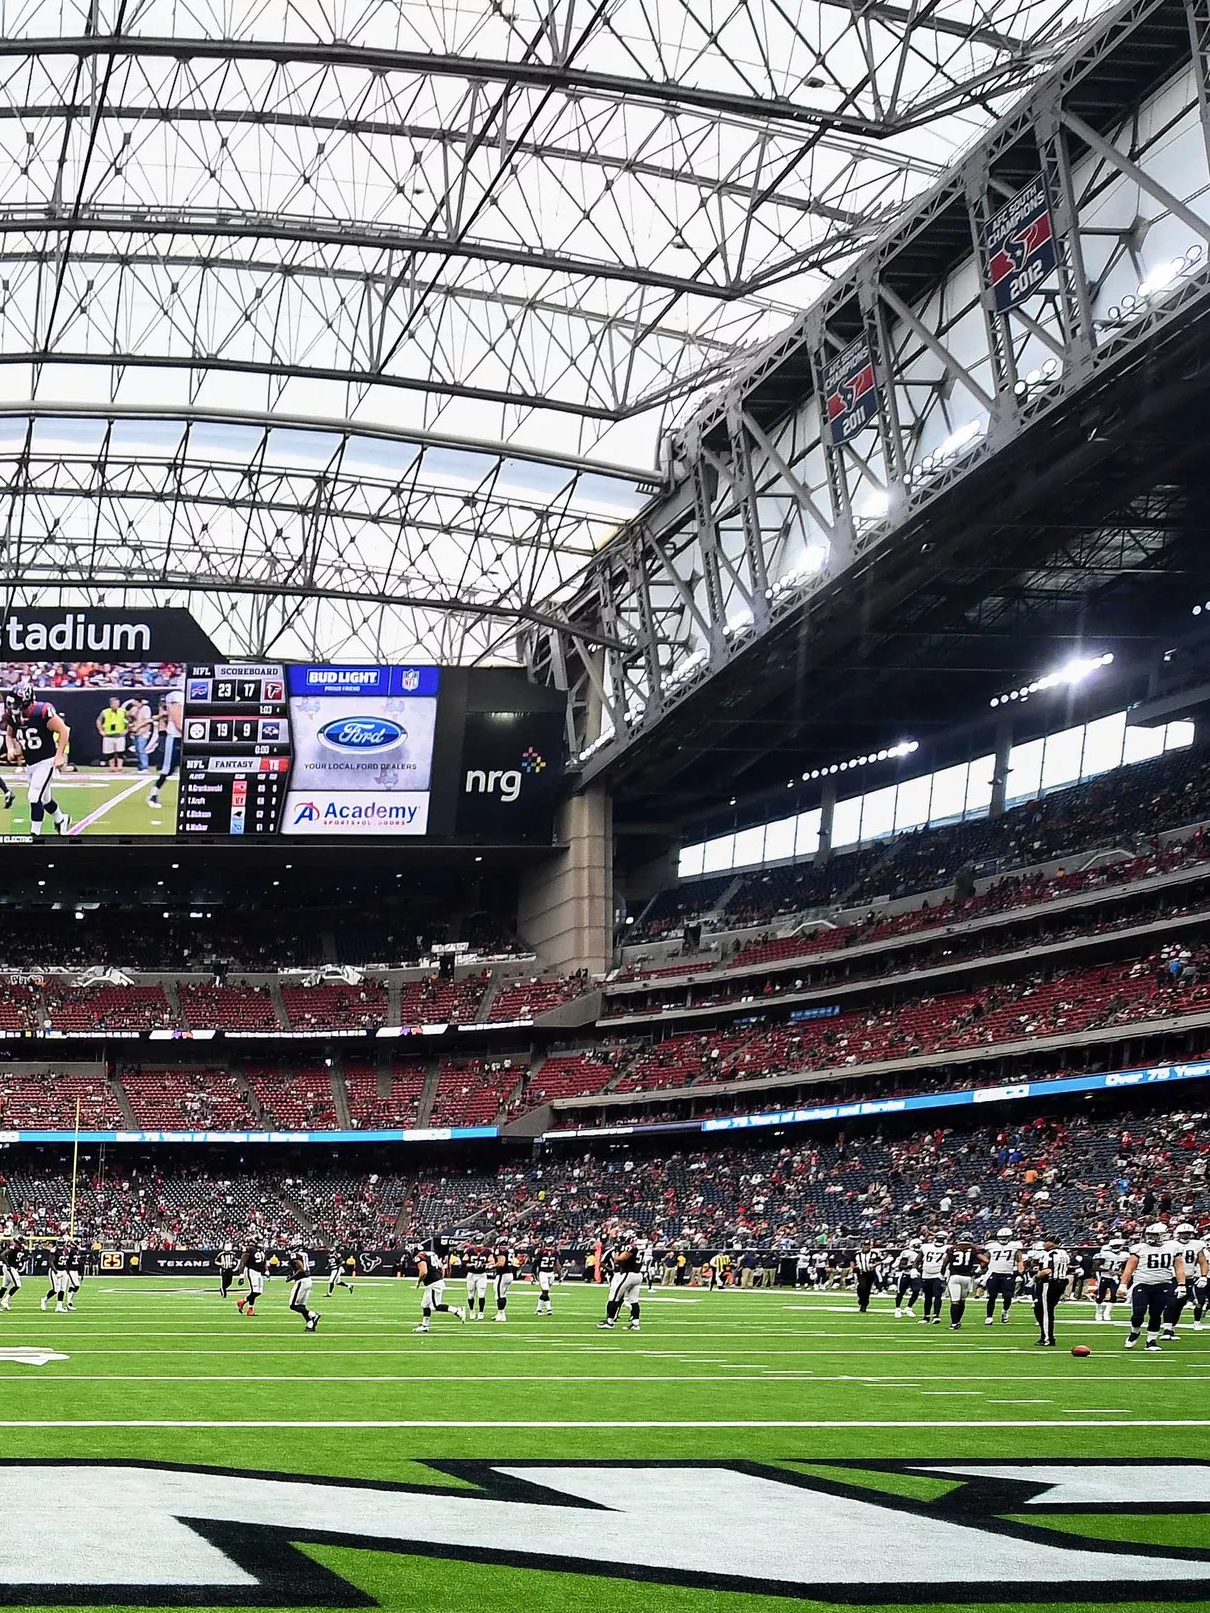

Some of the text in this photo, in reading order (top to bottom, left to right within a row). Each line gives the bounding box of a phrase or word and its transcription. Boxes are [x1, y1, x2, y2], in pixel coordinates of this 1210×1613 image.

[1009, 184, 1037, 214] SOUTH
[988, 190, 1045, 249] CHAMPIONS
[1009, 259, 1044, 301] 2012
[842, 405, 866, 437] 2011
[192, 667, 279, 676] NFL SCOREBOARD
[309, 671, 377, 684] BUD LIGHT
[218, 683, 232, 697] 23
[243, 683, 255, 697] 17
[216, 723, 228, 737] 19
[243, 723, 251, 737] 9
[338, 722, 386, 745] Ford
[215, 760, 254, 768] FANTASY
[466, 770, 522, 802] nrg
[324, 802, 418, 823] Academy
[103, 1254, 121, 1268] 25
[952, 1249, 971, 1266] 31
[992, 1250, 1012, 1261] 77
[1147, 1253, 1171, 1269] 60
